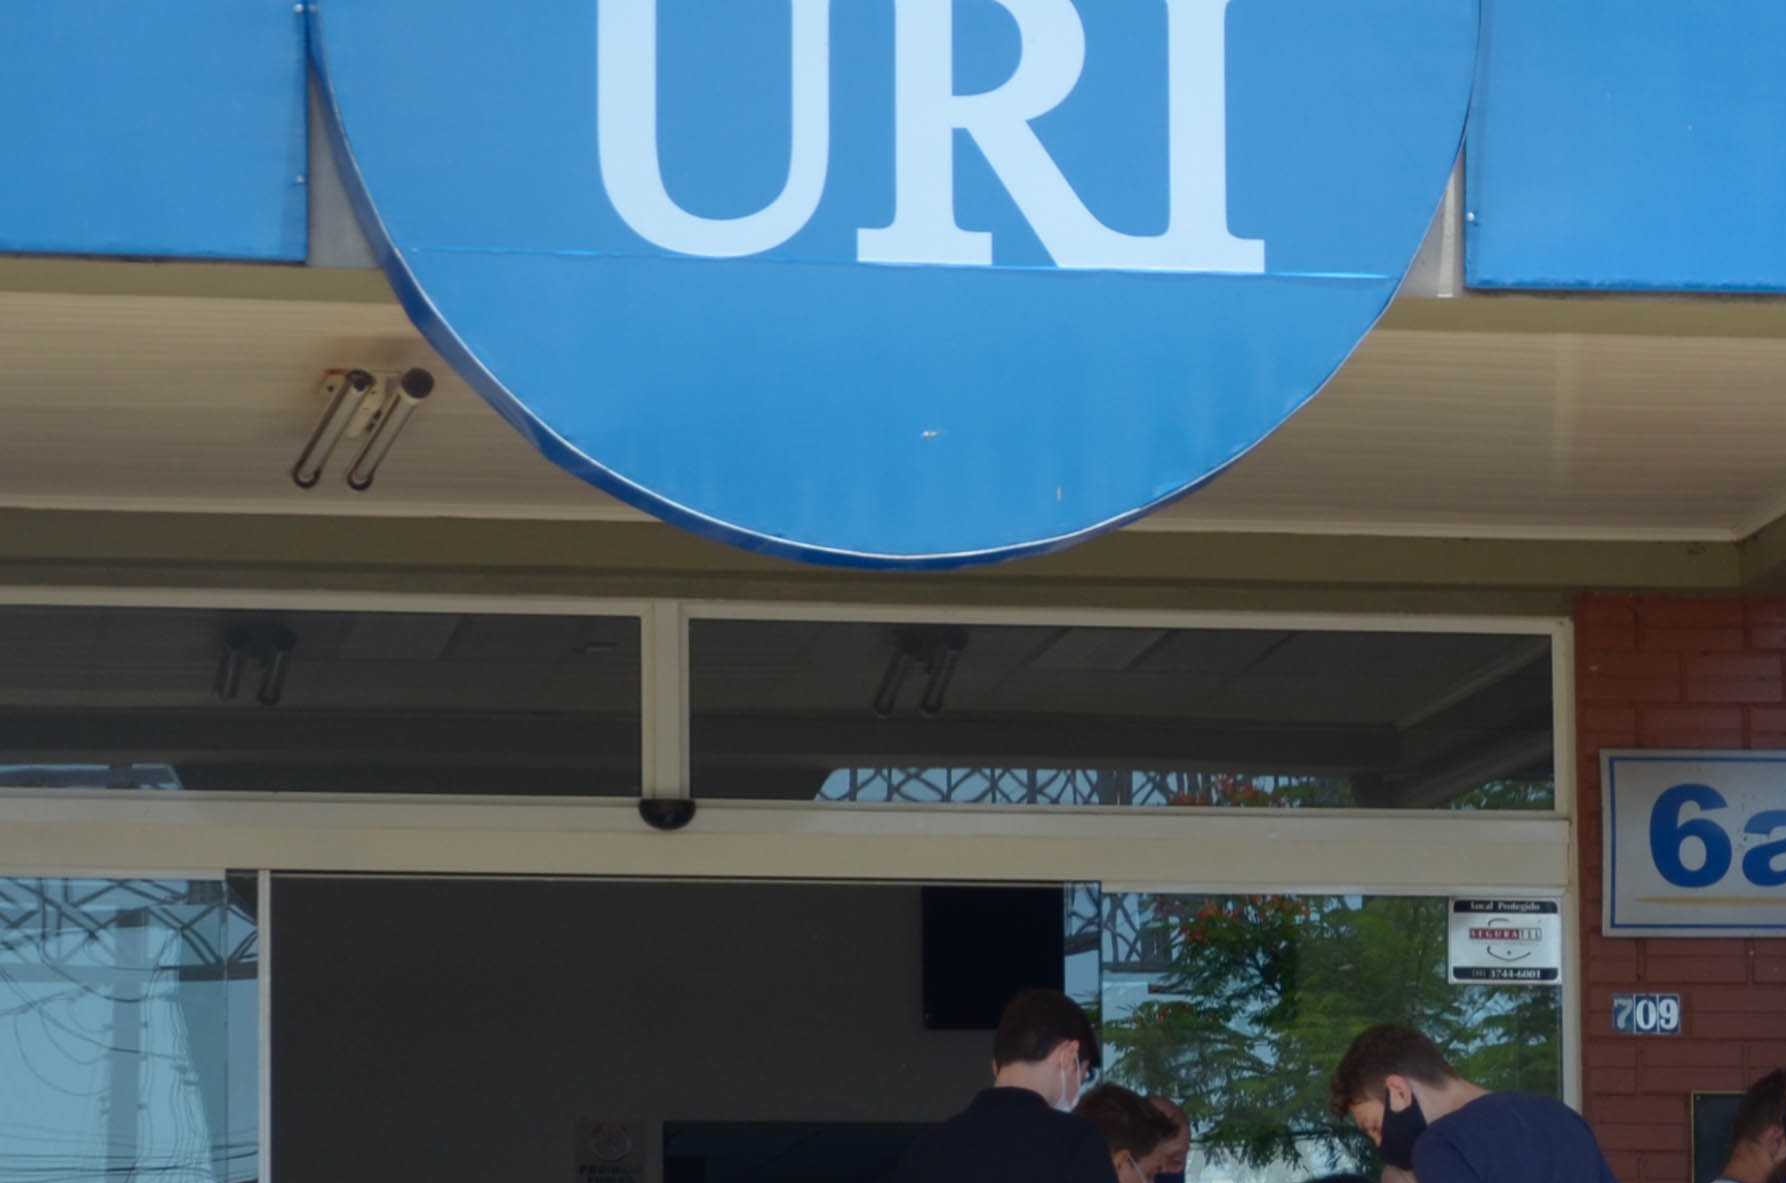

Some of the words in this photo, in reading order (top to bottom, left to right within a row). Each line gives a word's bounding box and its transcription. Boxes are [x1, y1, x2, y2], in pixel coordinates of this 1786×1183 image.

[598, 0, 1265, 273] URI
[1470, 901, 1494, 910] Local
[1498, 902, 1540, 912] Protegido
[1613, 997, 1679, 1030] 709
